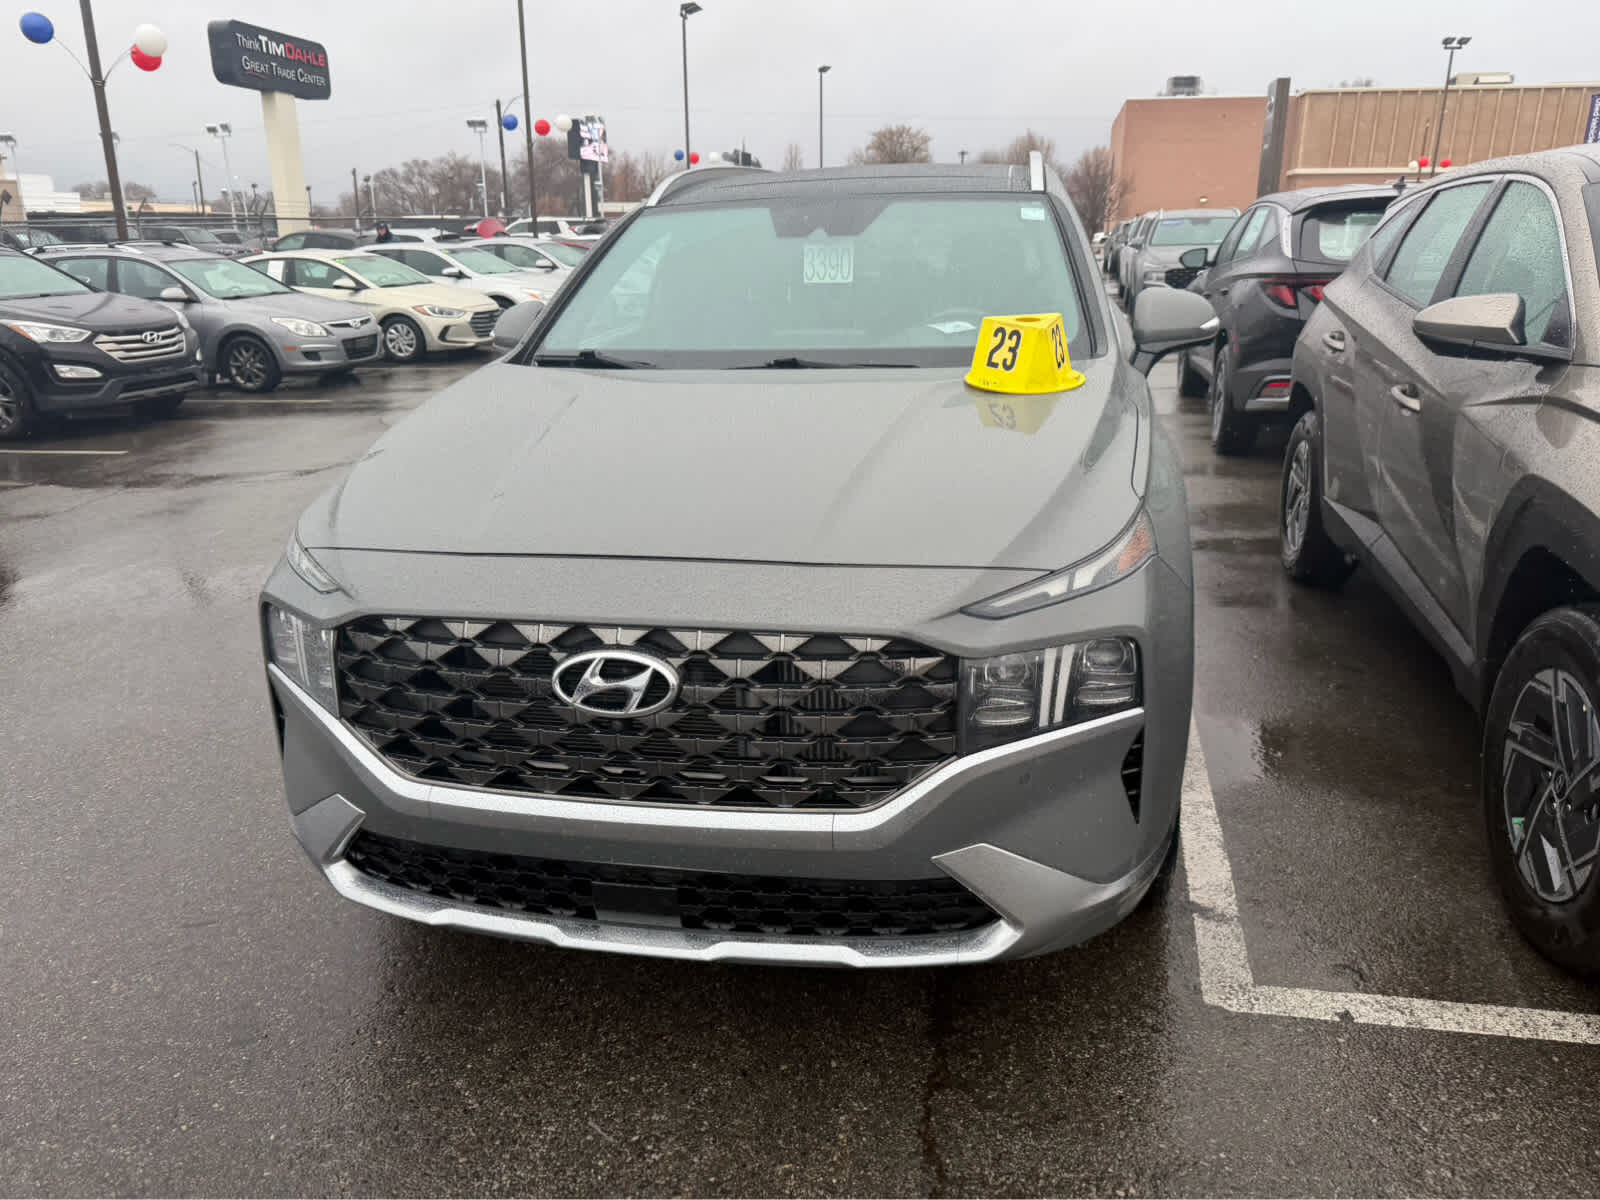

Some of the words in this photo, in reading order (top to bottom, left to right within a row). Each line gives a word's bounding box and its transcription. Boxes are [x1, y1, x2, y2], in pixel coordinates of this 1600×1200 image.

[236, 33, 260, 52] Think
[242, 55, 269, 73] GREAT
[271, 62, 297, 80] TRADE
[297, 68, 326, 86] CENTER
[804, 247, 851, 281] 3390
[986, 327, 1022, 371] 23
[1052, 324, 1065, 368] 23
